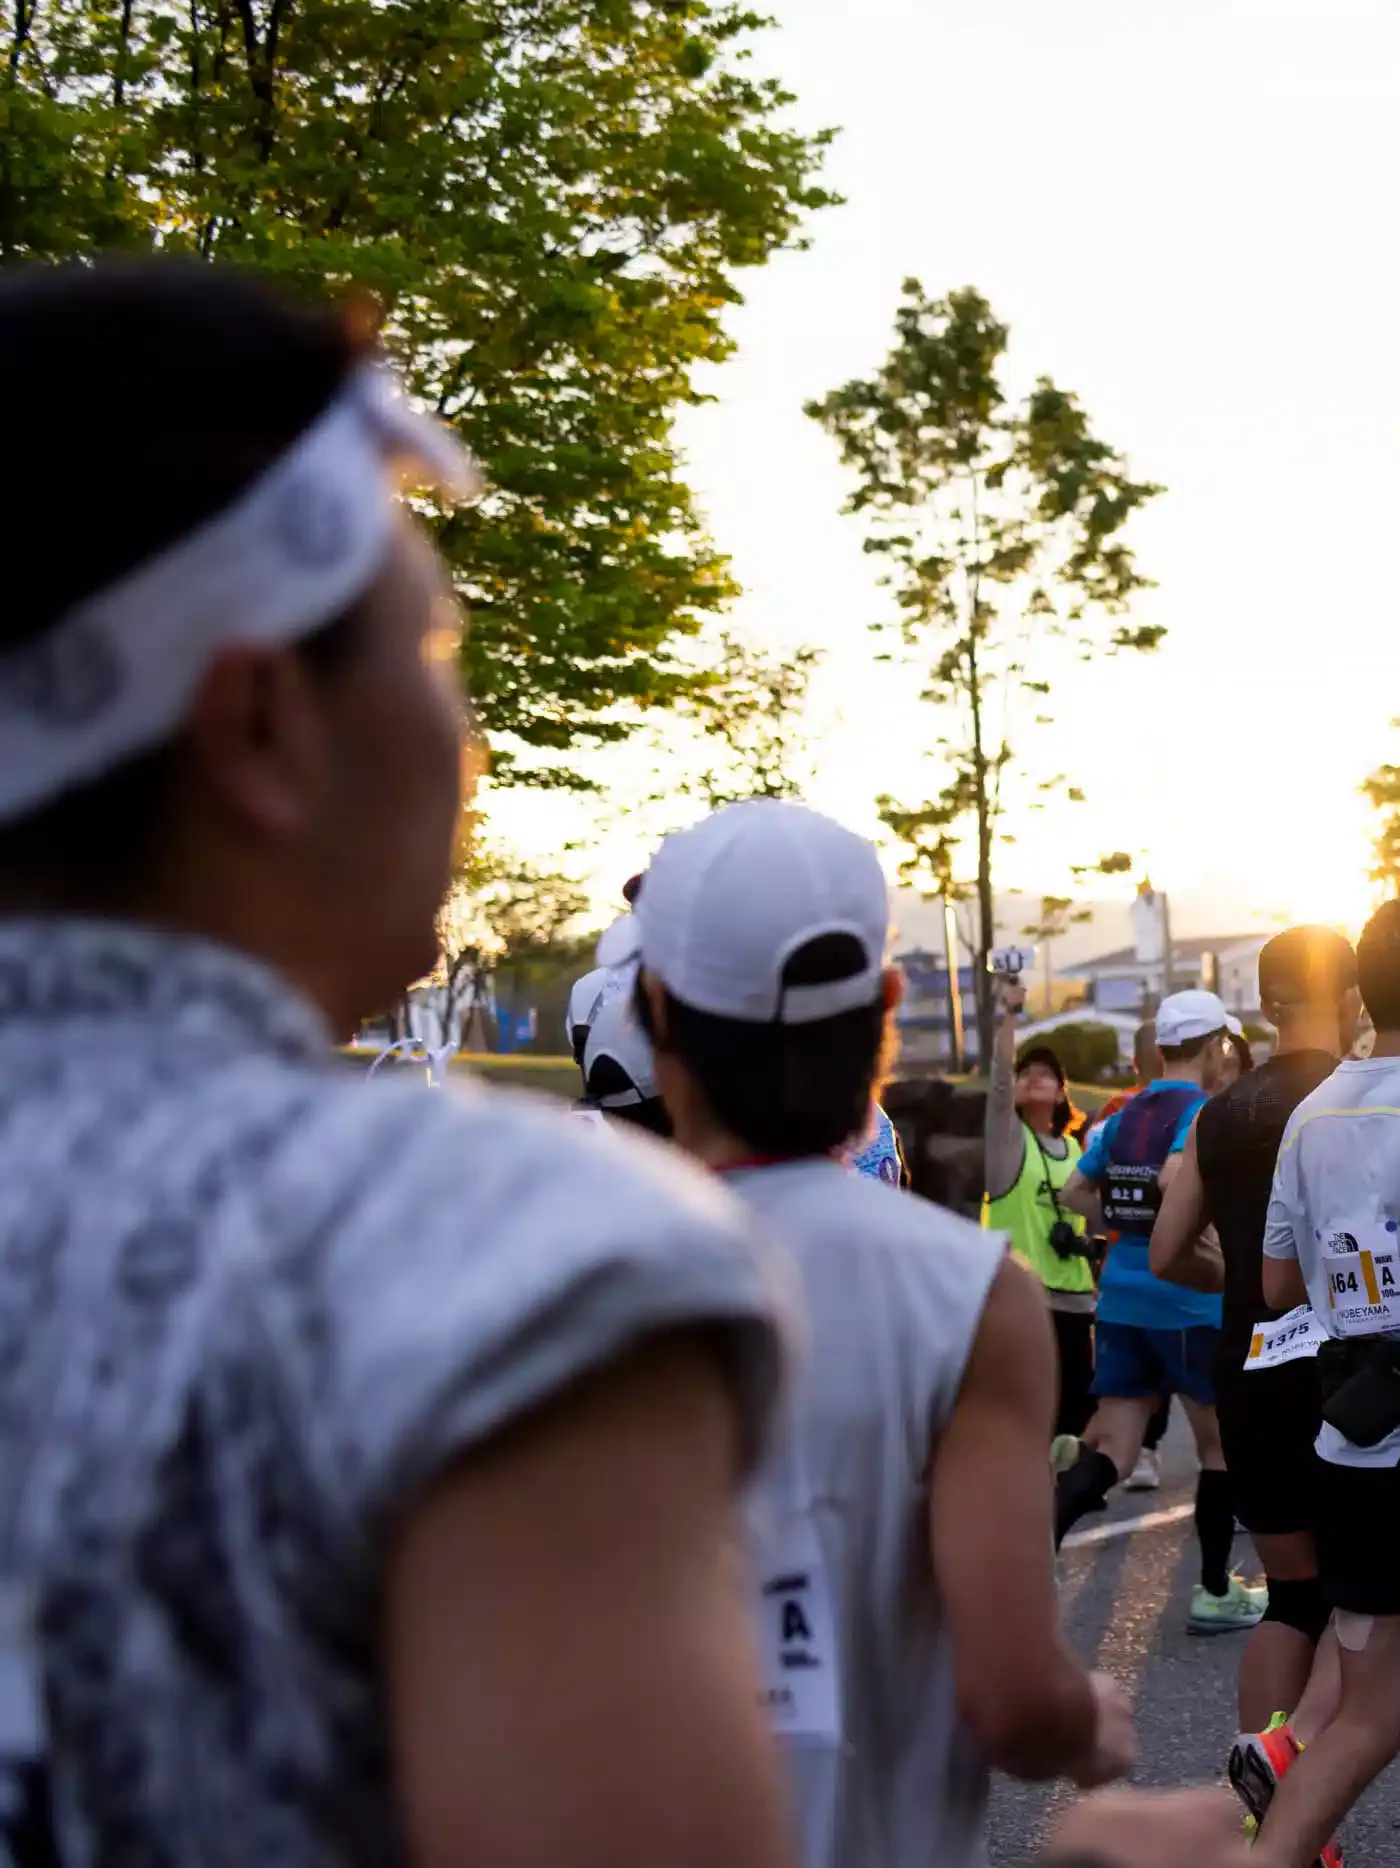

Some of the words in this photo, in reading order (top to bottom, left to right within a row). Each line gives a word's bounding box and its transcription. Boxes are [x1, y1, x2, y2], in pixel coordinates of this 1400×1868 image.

[1374, 1254, 1393, 1265] WAVE
[1382, 1266, 1396, 1287] A
[1266, 1322, 1310, 1350] 1375
[781, 1599, 813, 1644] A
